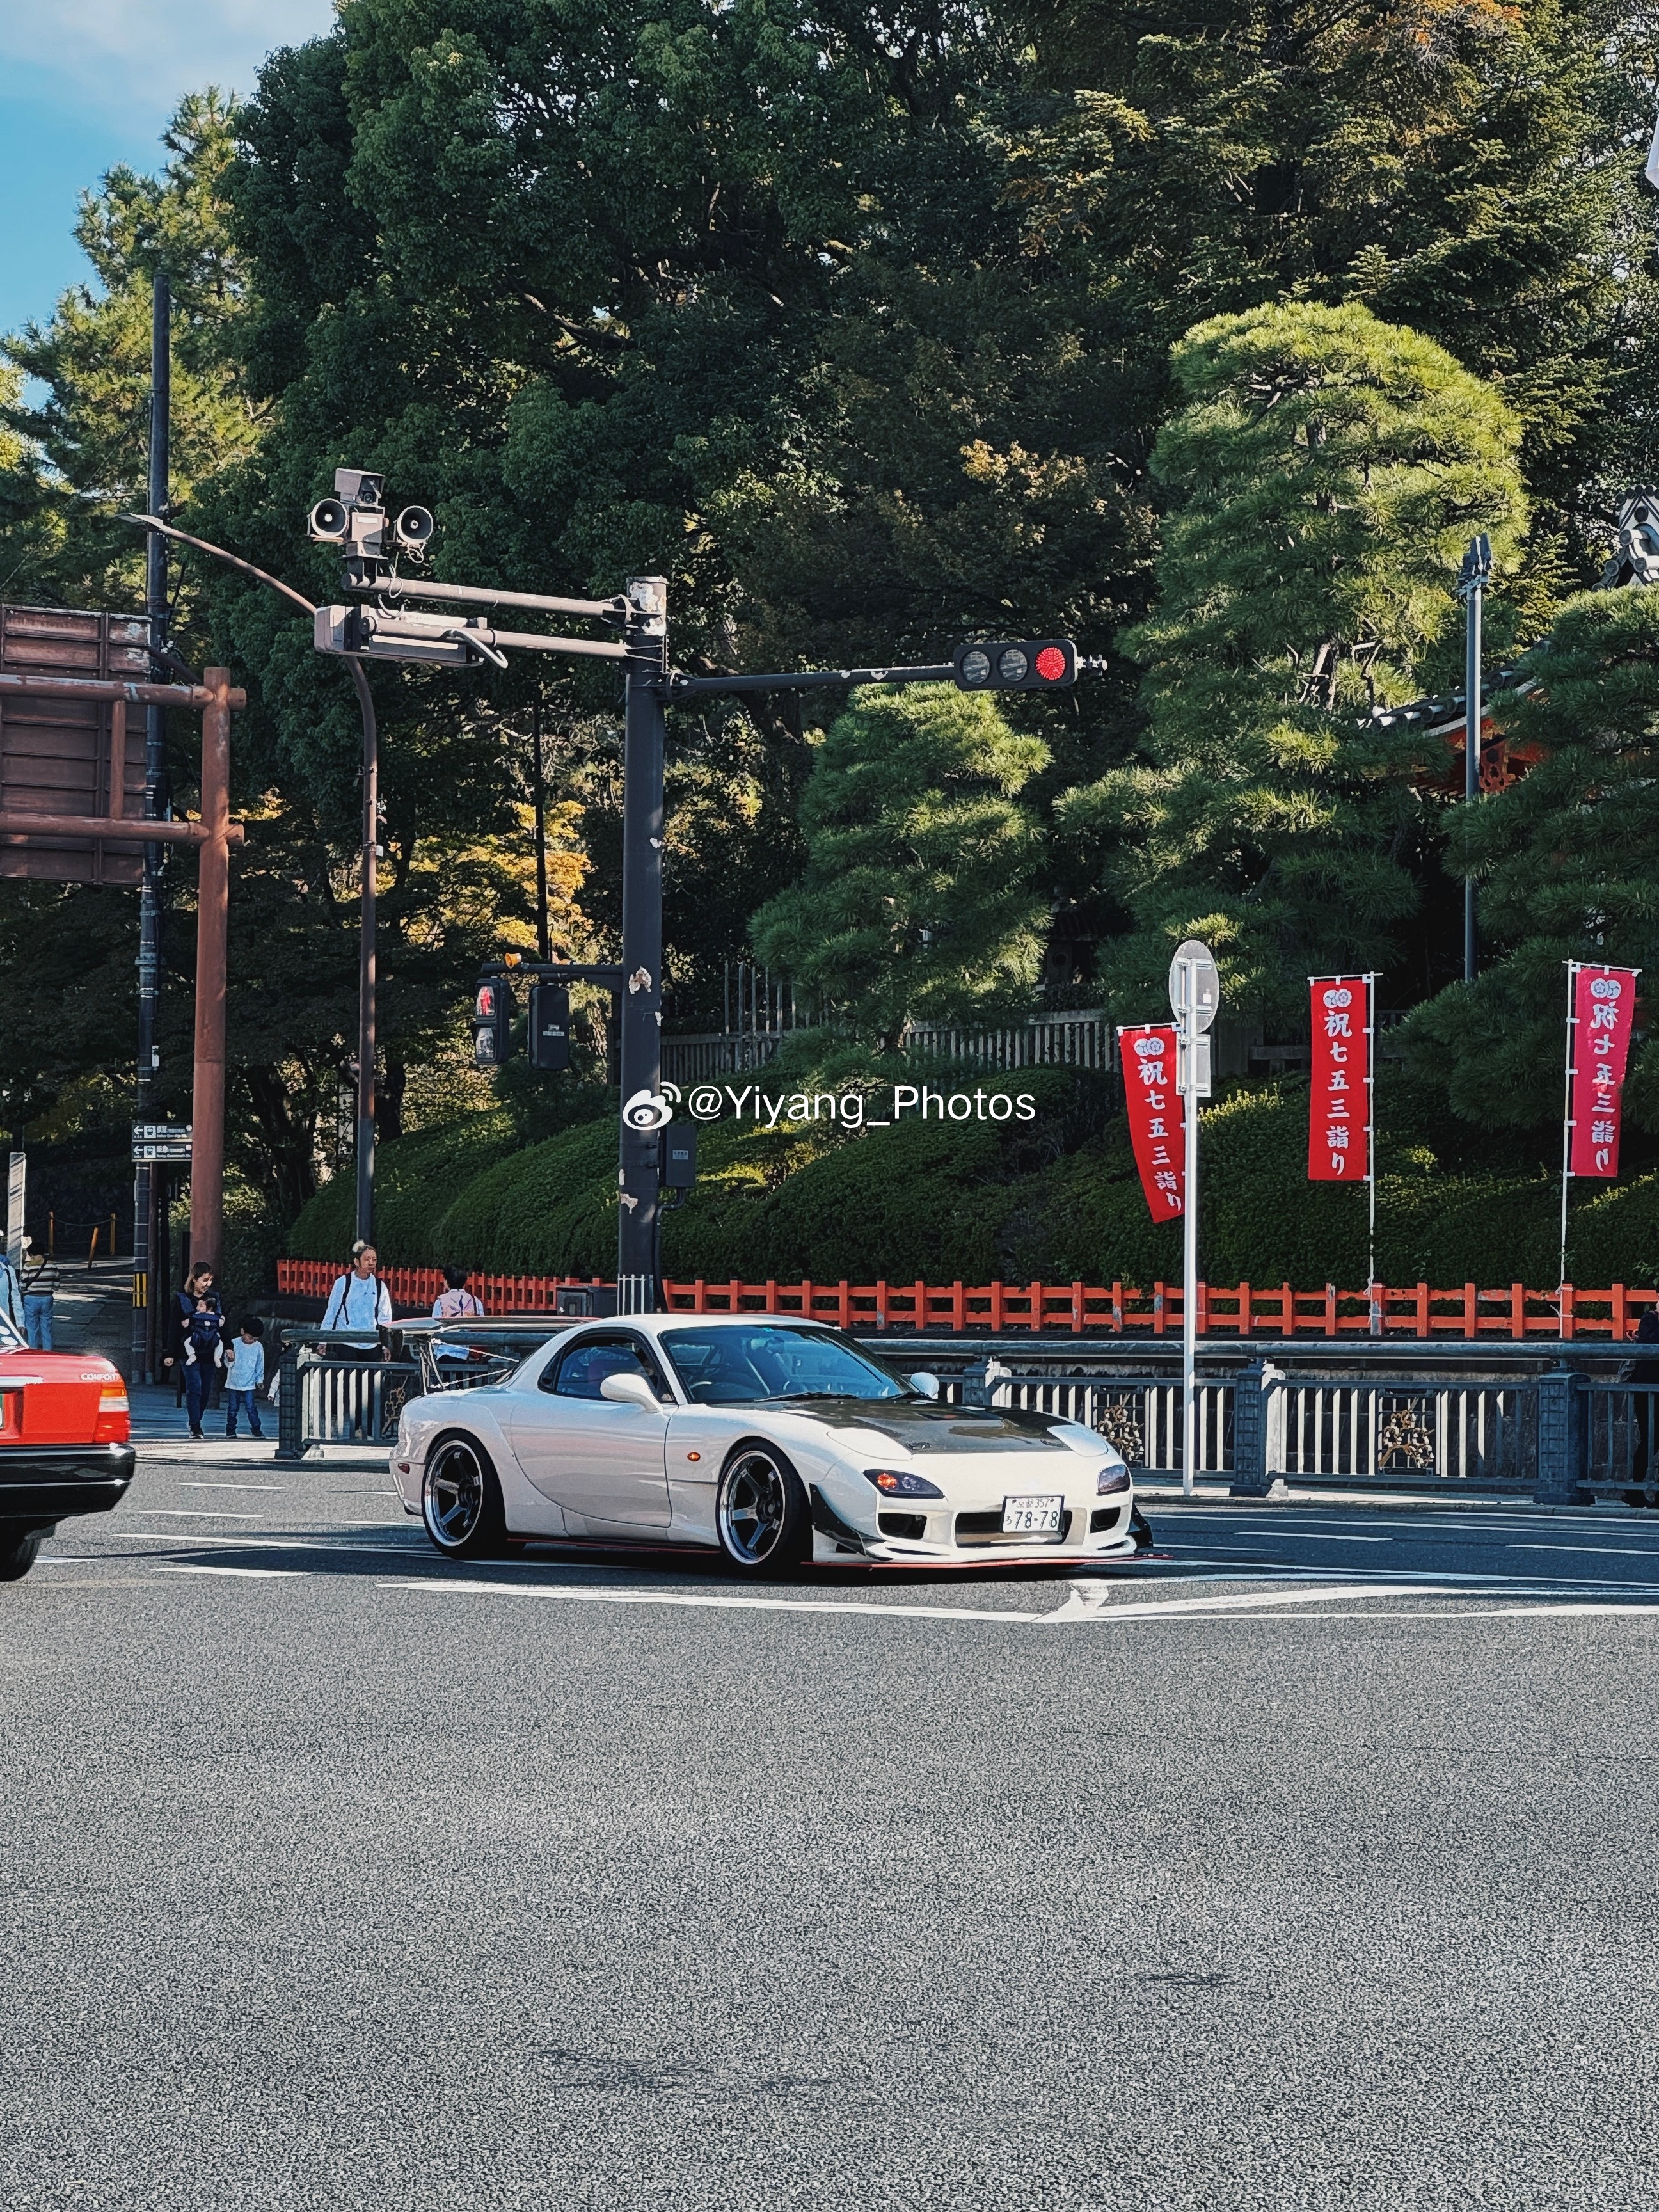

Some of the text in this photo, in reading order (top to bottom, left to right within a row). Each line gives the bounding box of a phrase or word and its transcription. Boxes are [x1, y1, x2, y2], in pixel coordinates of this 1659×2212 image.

[1137, 1058, 1182, 1211] 祝七五三詣り
[1324, 1009, 1353, 1176] 祝七五三詣り
[1015, 1510, 1058, 1529] 78-78
[1035, 1498, 1050, 1508] 357
